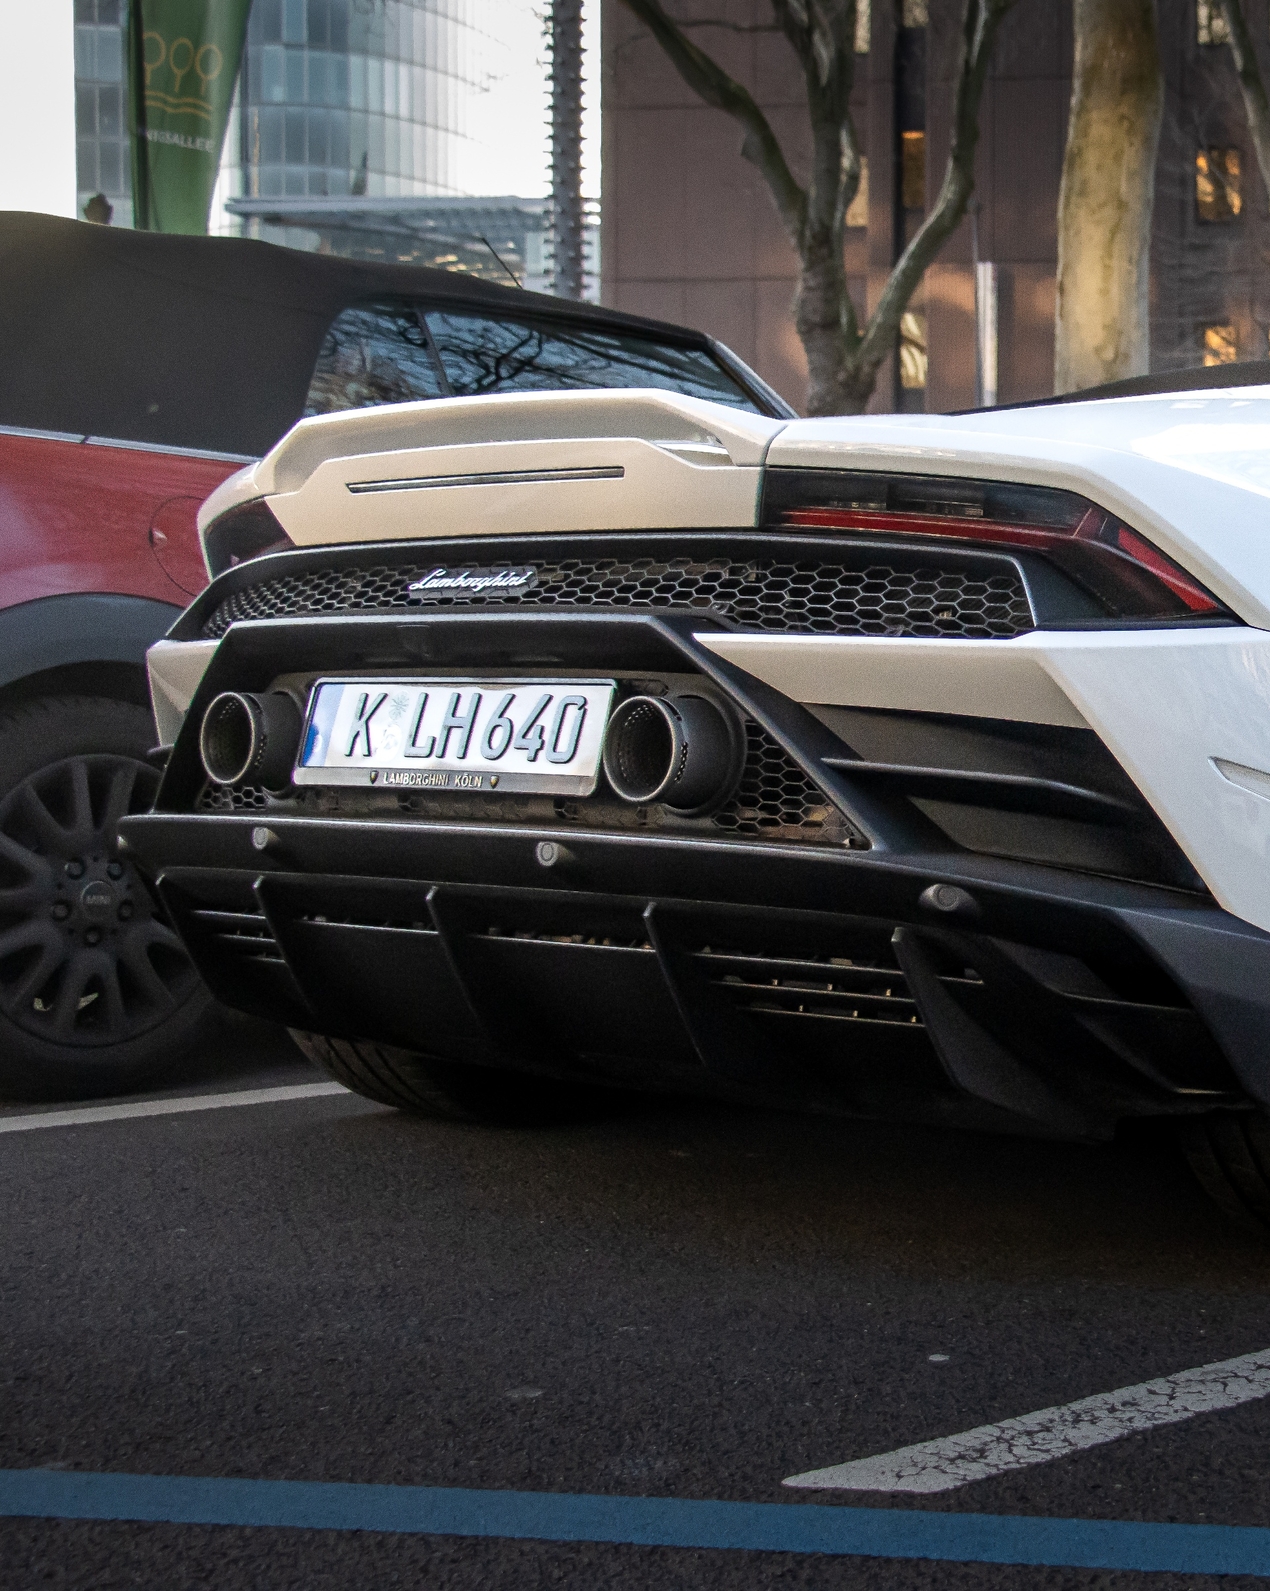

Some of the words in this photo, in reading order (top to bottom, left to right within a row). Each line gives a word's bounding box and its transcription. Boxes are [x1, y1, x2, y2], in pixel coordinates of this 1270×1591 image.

[408, 568, 533, 592] Lamborghini
[344, 692, 388, 757] K
[383, 772, 450, 786] LAMBORGHINI
[454, 774, 482, 788] KÖLN
